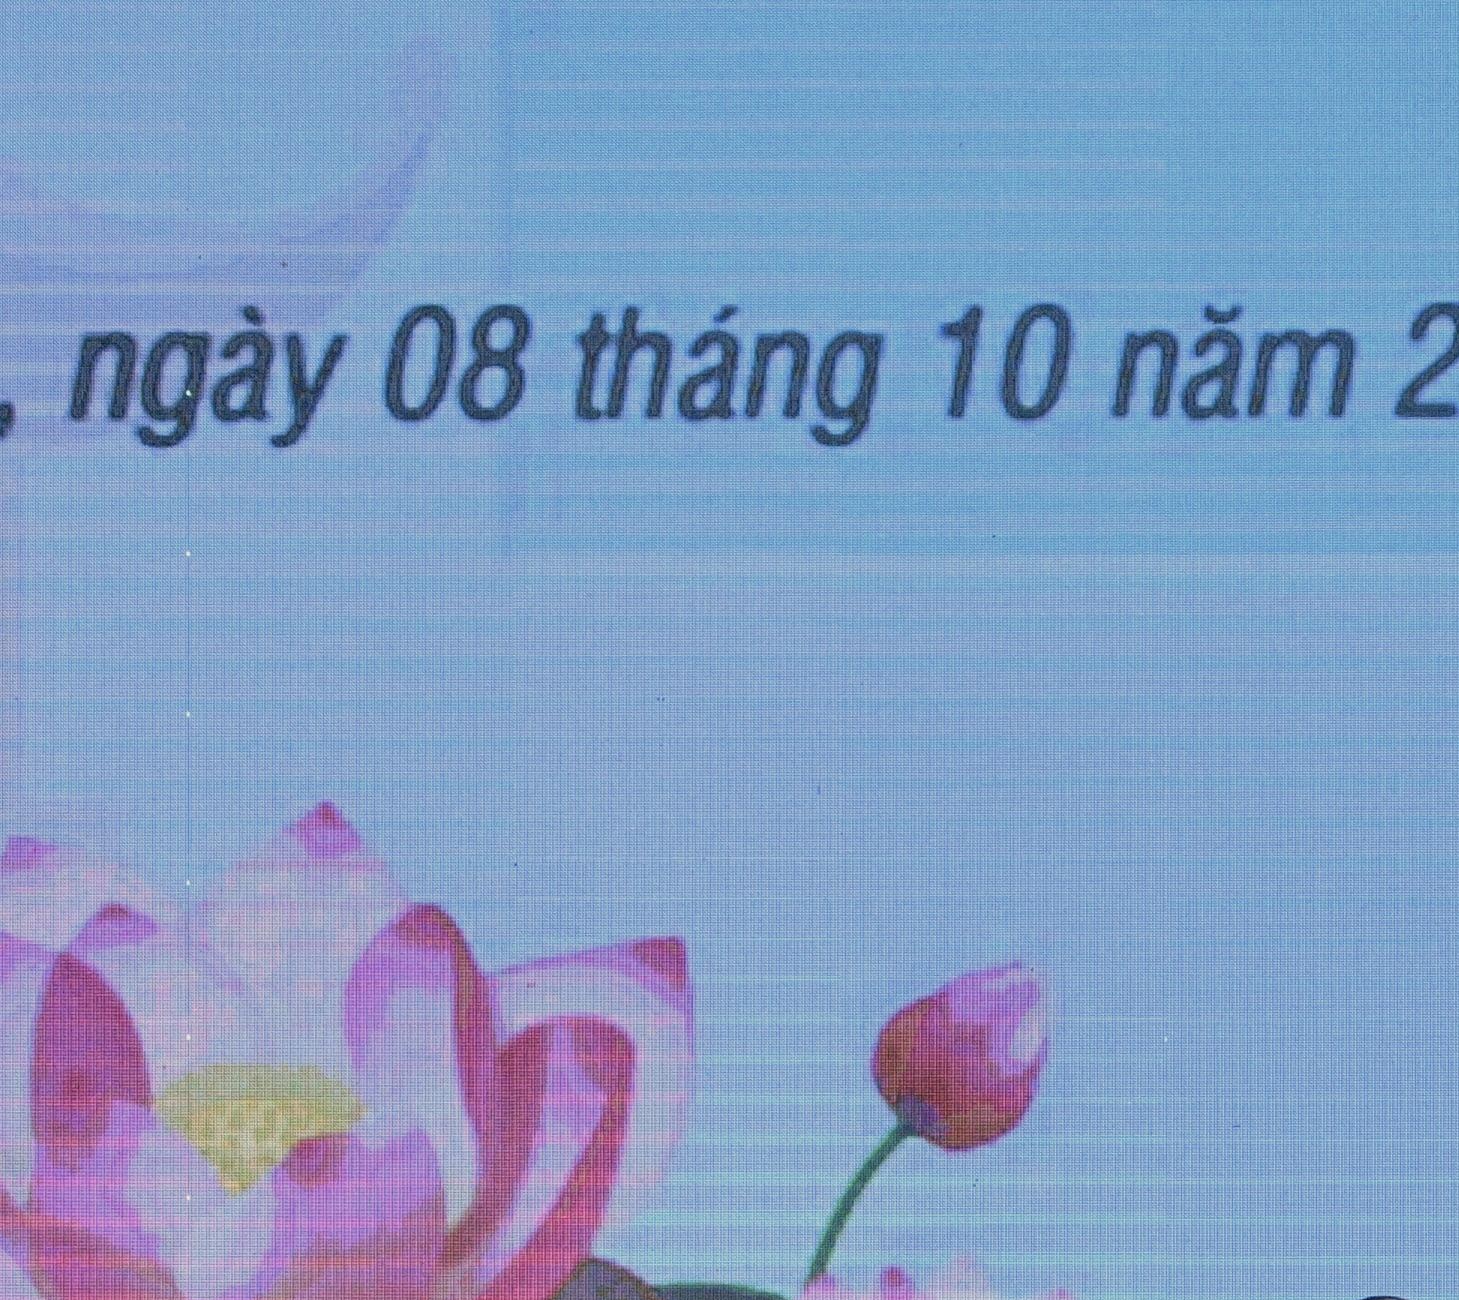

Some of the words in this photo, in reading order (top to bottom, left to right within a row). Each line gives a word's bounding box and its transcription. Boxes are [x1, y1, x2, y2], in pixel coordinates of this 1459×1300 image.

[69, 306, 346, 449] ngày
[384, 304, 532, 423] 08
[575, 307, 883, 447] tháng
[943, 303, 1072, 422] 10
[1112, 307, 1356, 421] năm
